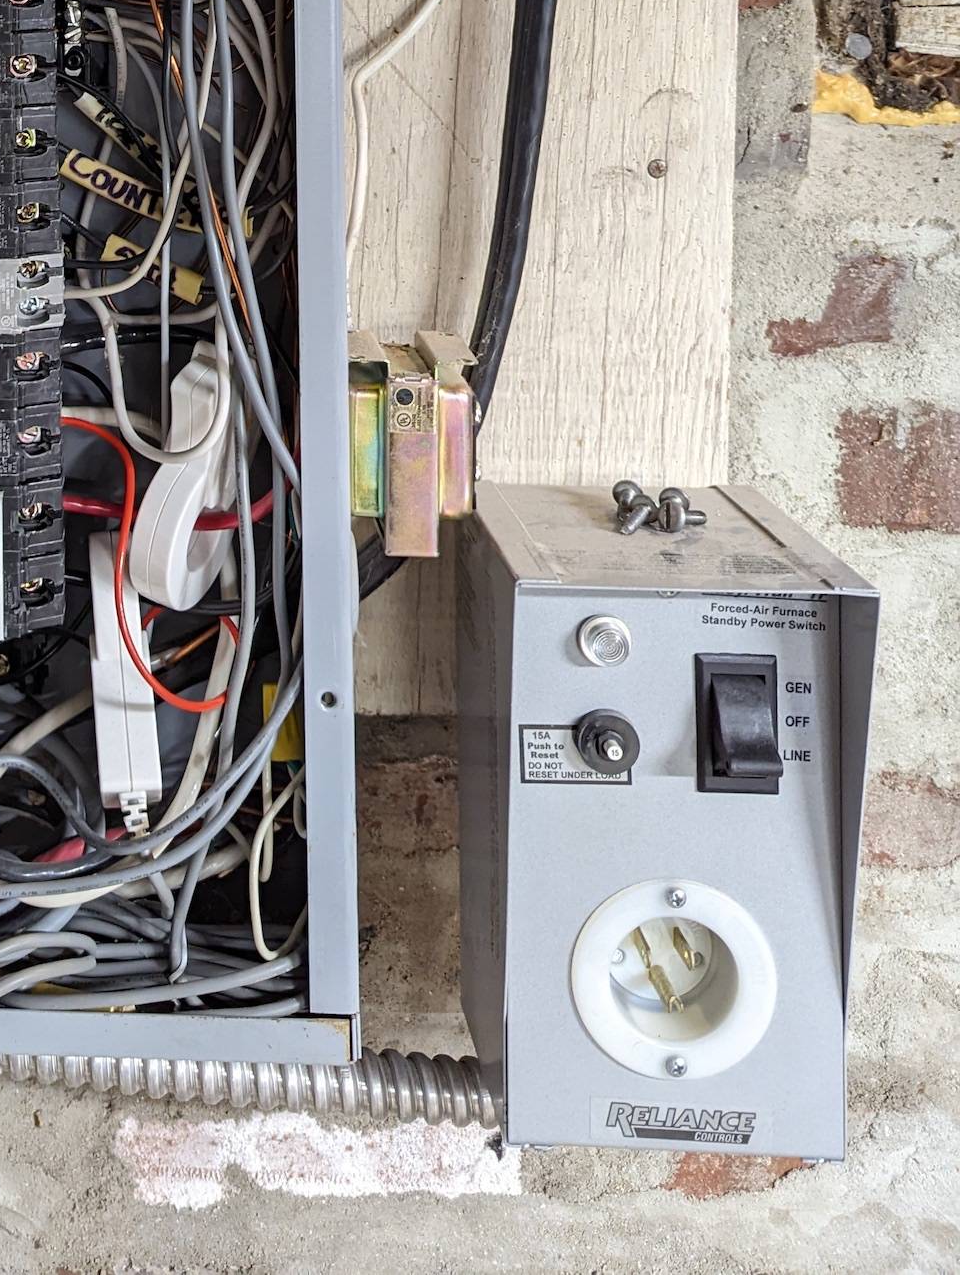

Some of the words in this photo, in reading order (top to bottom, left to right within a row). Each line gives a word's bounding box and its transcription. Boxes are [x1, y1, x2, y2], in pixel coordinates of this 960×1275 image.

[711, 602, 769, 615] Forced-Air
[772, 606, 818, 618] Furnace
[702, 615, 747, 629] Standby
[751, 618, 785, 629] Power
[788, 620, 826, 631] Switch
[785, 682, 812, 694] GEN
[785, 716, 810, 728] OFF
[532, 731, 551, 740] 15A
[527, 742, 551, 750] Push
[554, 742, 565, 750] to
[530, 751, 559, 759] Reset
[783, 749, 811, 762] LINE
[528, 770, 558, 778] RESET
[561, 771, 593, 779] UNDER
[606, 1102, 756, 1138] RELIANCE
[694, 1131, 743, 1143] CONTROLS
